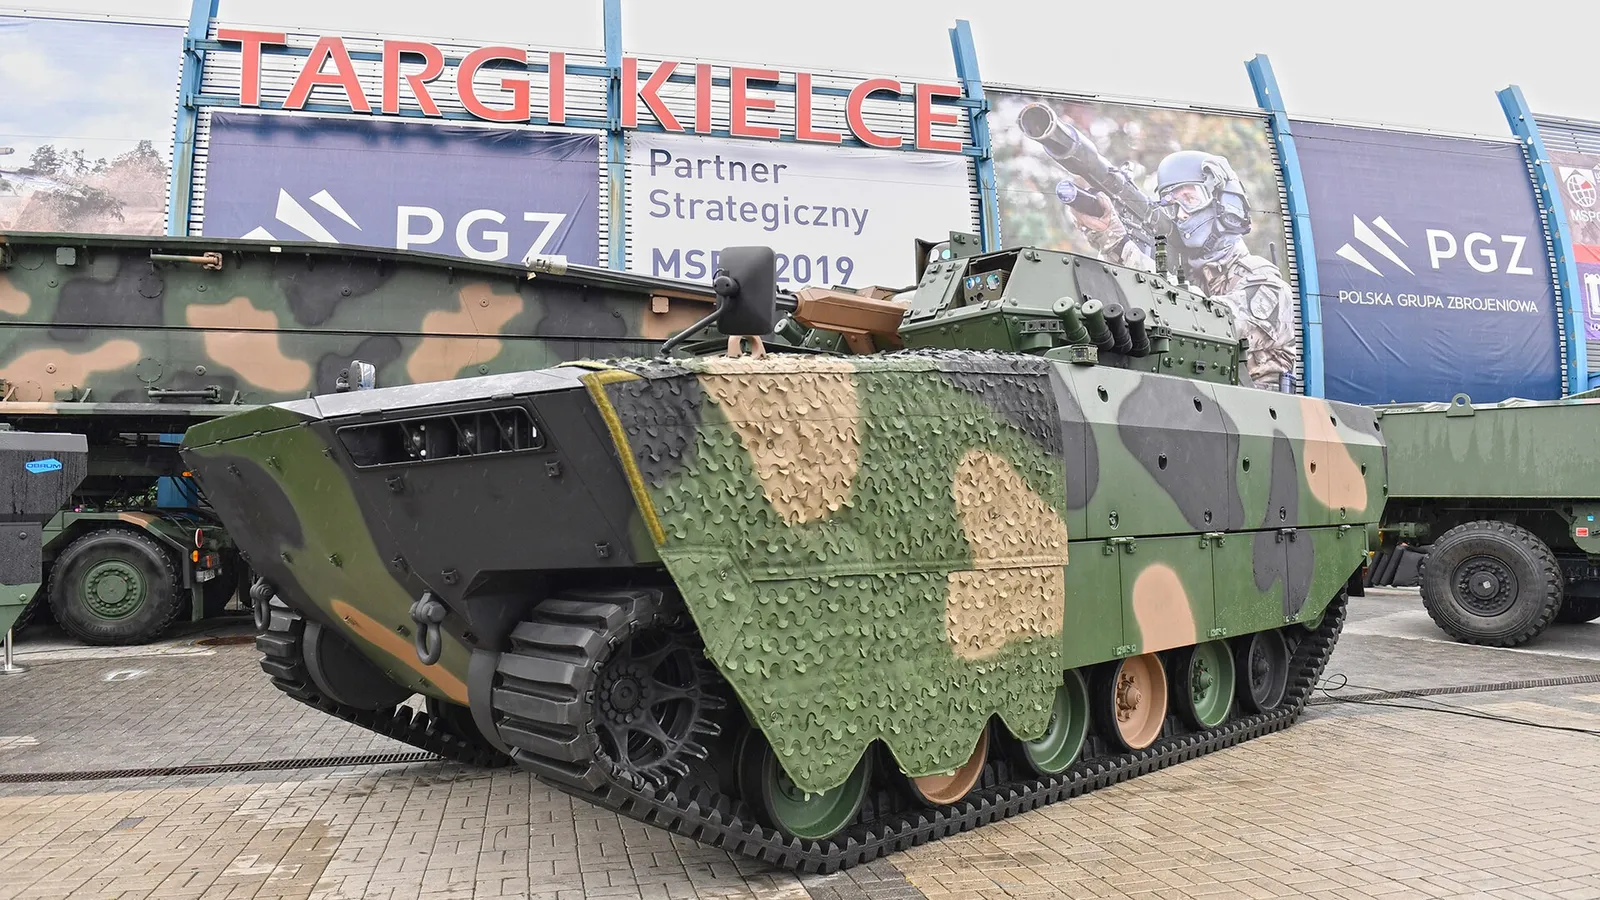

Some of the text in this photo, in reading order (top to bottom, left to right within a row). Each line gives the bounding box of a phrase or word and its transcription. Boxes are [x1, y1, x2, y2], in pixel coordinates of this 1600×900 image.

[217, 29, 962, 152] TARGI KIELCE
[650, 149, 787, 184] Partner
[397, 205, 567, 262] PGZ
[649, 188, 868, 236] Strategiczny
[775, 253, 854, 286] 2019
[1425, 228, 1534, 275] PGZ
[1339, 290, 1538, 313] POLSKA GRUPA ZBROJENIOWA
